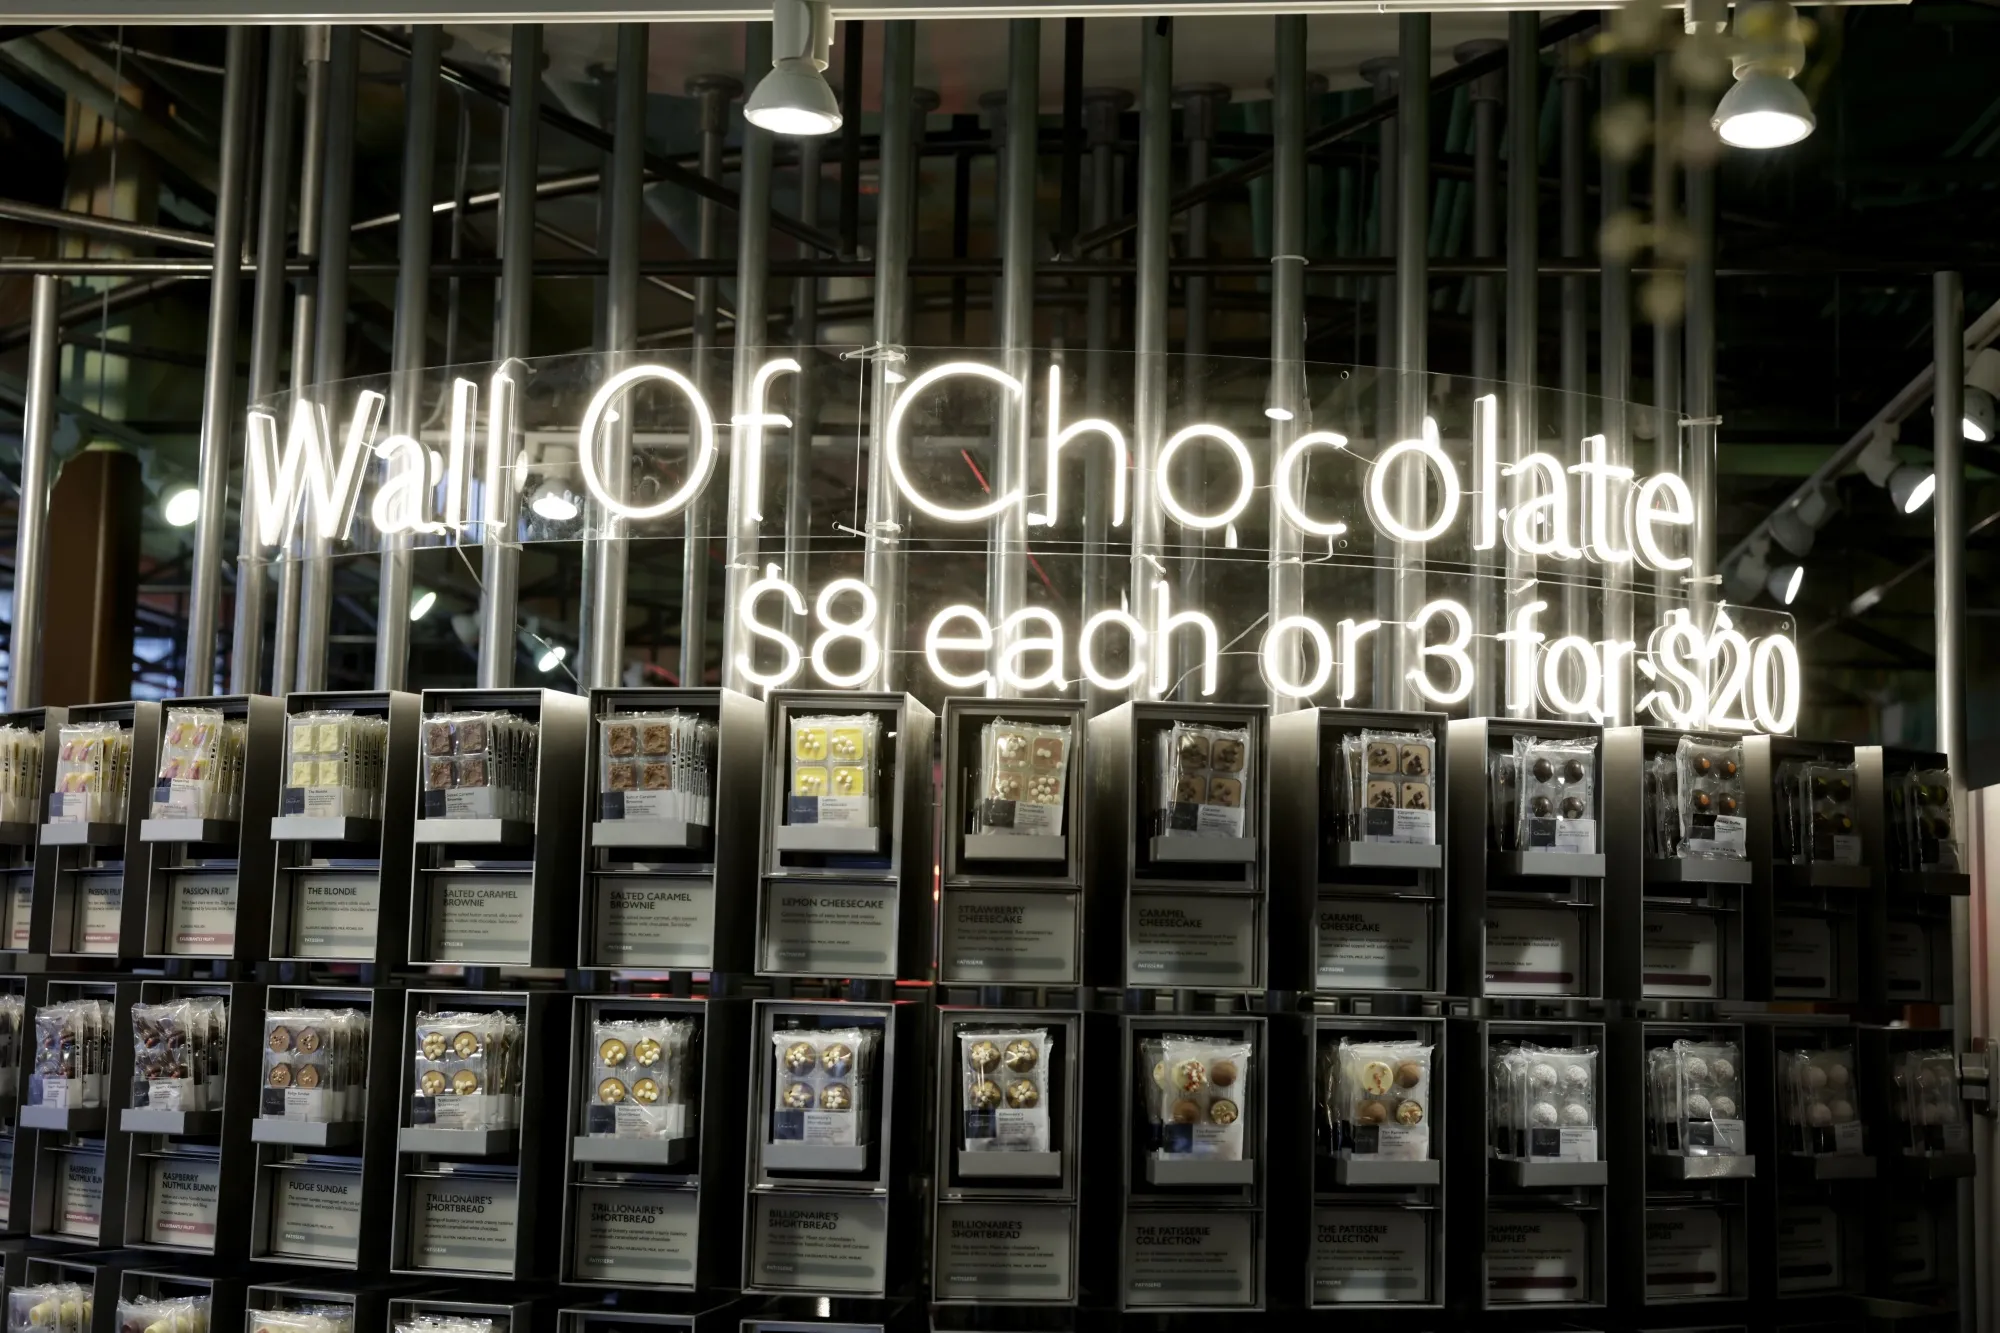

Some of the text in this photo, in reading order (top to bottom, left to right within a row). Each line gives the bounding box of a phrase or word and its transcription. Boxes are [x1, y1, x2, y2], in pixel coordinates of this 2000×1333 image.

[247, 357, 1694, 572] Wall Of Chocolate
[735, 562, 1802, 736] $8 each or 3 for $20
[183, 887, 230, 896] PASSION FRUIT
[308, 887, 357, 896] THE BLONDIE
[444, 889, 518, 899] SALTED CARAMEL
[610, 891, 692, 902] SALTED CARAMEL
[443, 898, 484, 907] BROWNIE
[610, 901, 655, 910] BROWNIE
[781, 898, 884, 909] LEMON CHEESECAKE
[958, 905, 1025, 915] STRAWBERRY
[1139, 909, 1186, 918] CARAMEL
[958, 914, 1023, 924] CHEESECAKE
[1139, 918, 1203, 928] CHEESECAKE
[1320, 913, 1364, 923] CARAMEL
[1320, 922, 1380, 932] CHEESECAKE
[69, 1165, 97, 1175] RASPBERRY
[163, 1172, 199, 1182] RASPBERRY
[162, 1181, 218, 1192] NUTMILK BUNNY
[289, 1181, 348, 1194] FUDGE SUNDAE
[426, 1193, 493, 1205] TRILLIONAIRE'S
[426, 1203, 485, 1214] SHORTBREAD
[592, 1203, 664, 1215] TRILLIONAIRE'S
[591, 1213, 656, 1224] SHORTBREAD
[769, 1209, 839, 1221] BILLIONAIRE'S
[769, 1219, 837, 1230] SHORTBREAD
[952, 1220, 1023, 1230] BILLIONAIRE'S
[1317, 1225, 1389, 1234] THE PATISSERIE
[951, 1229, 1020, 1239] SHORTBREAD
[1136, 1226, 1211, 1236] THE PATISSERIE
[1136, 1236, 1201, 1245] COLLECTION
[1317, 1234, 1379, 1243] COLLECTION
